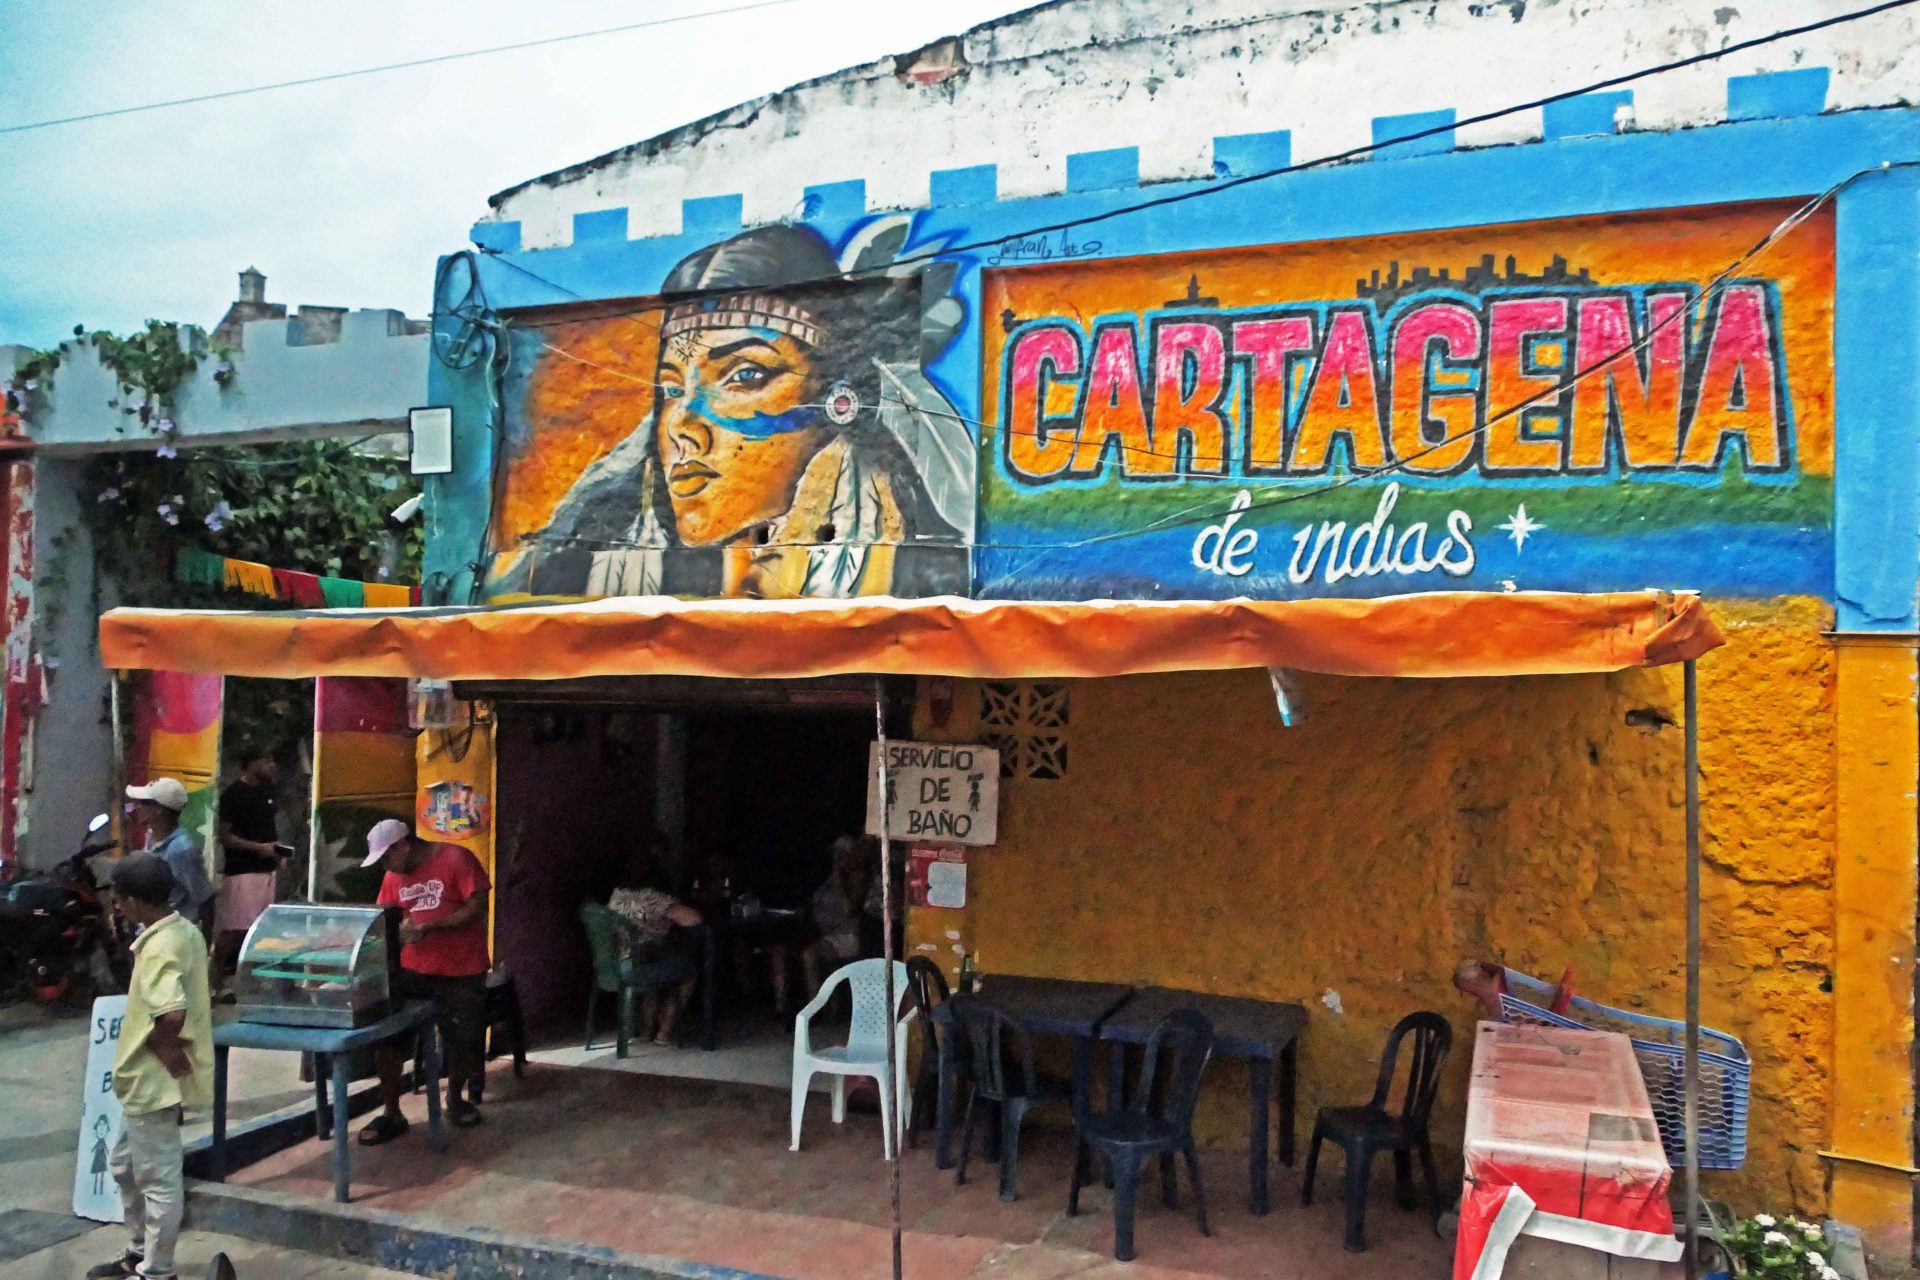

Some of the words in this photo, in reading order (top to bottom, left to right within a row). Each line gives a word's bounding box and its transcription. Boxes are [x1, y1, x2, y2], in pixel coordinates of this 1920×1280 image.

[1004, 280, 1793, 485] CARTAGENA
[1192, 489, 1258, 576] de
[889, 746, 974, 771] SERVICIO
[920, 777, 951, 804] DE
[906, 809, 972, 838] BAÑO
